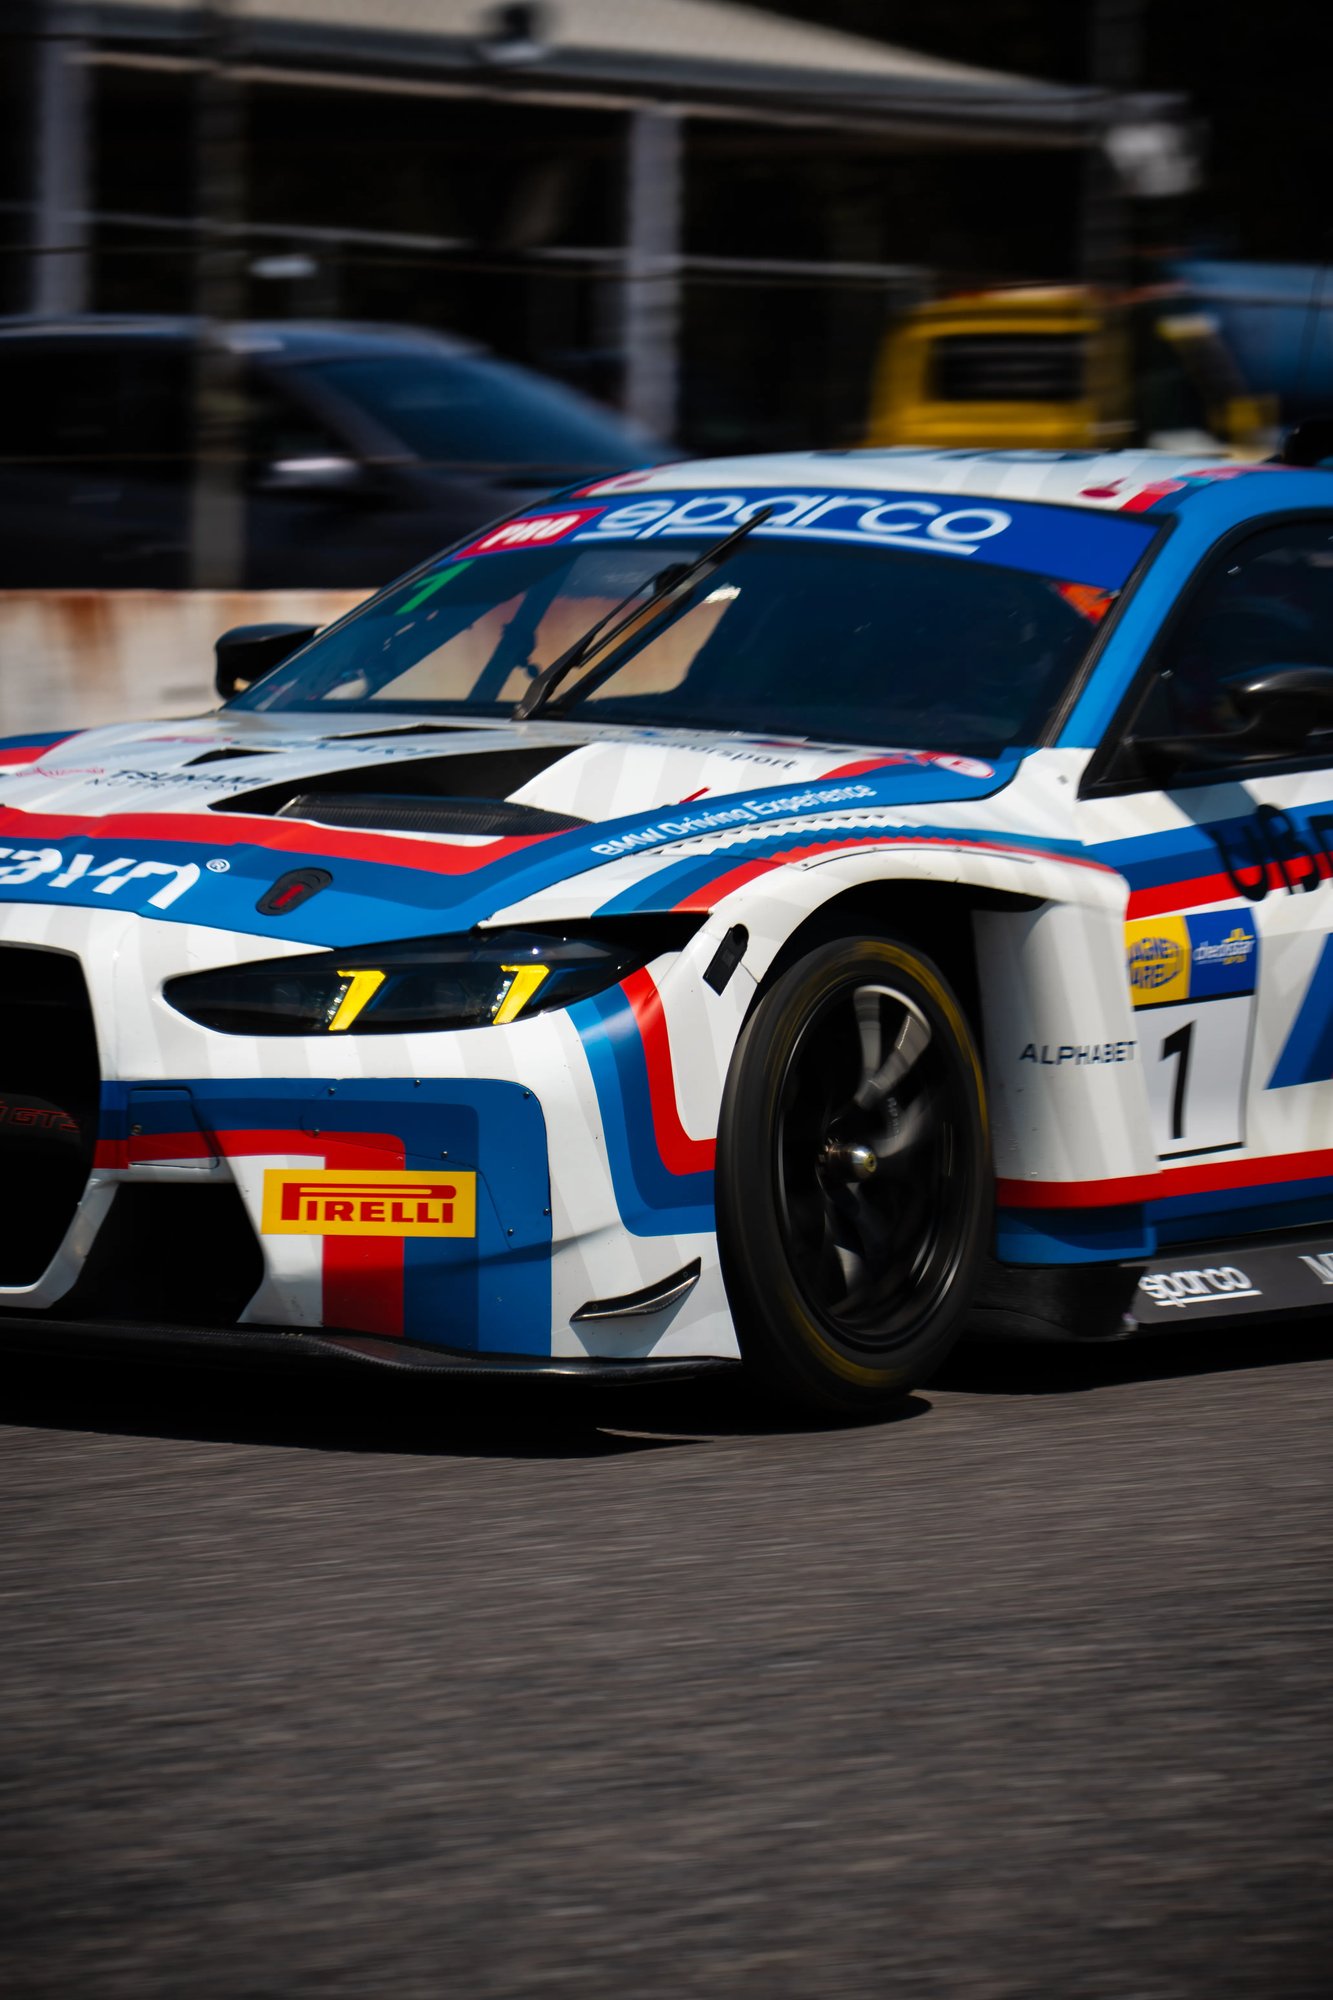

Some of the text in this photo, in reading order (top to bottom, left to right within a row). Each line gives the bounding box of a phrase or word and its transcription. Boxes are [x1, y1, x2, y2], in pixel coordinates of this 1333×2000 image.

[477, 514, 582, 549] PRO
[598, 495, 1012, 546] sparco
[590, 785, 878, 857] BMW Driving Experience
[1019, 1040, 1138, 1066] ALPHABET
[1159, 1019, 1198, 1140] 1
[280, 1182, 457, 1224] PIRELLI
[1138, 1266, 1253, 1308] sparco
